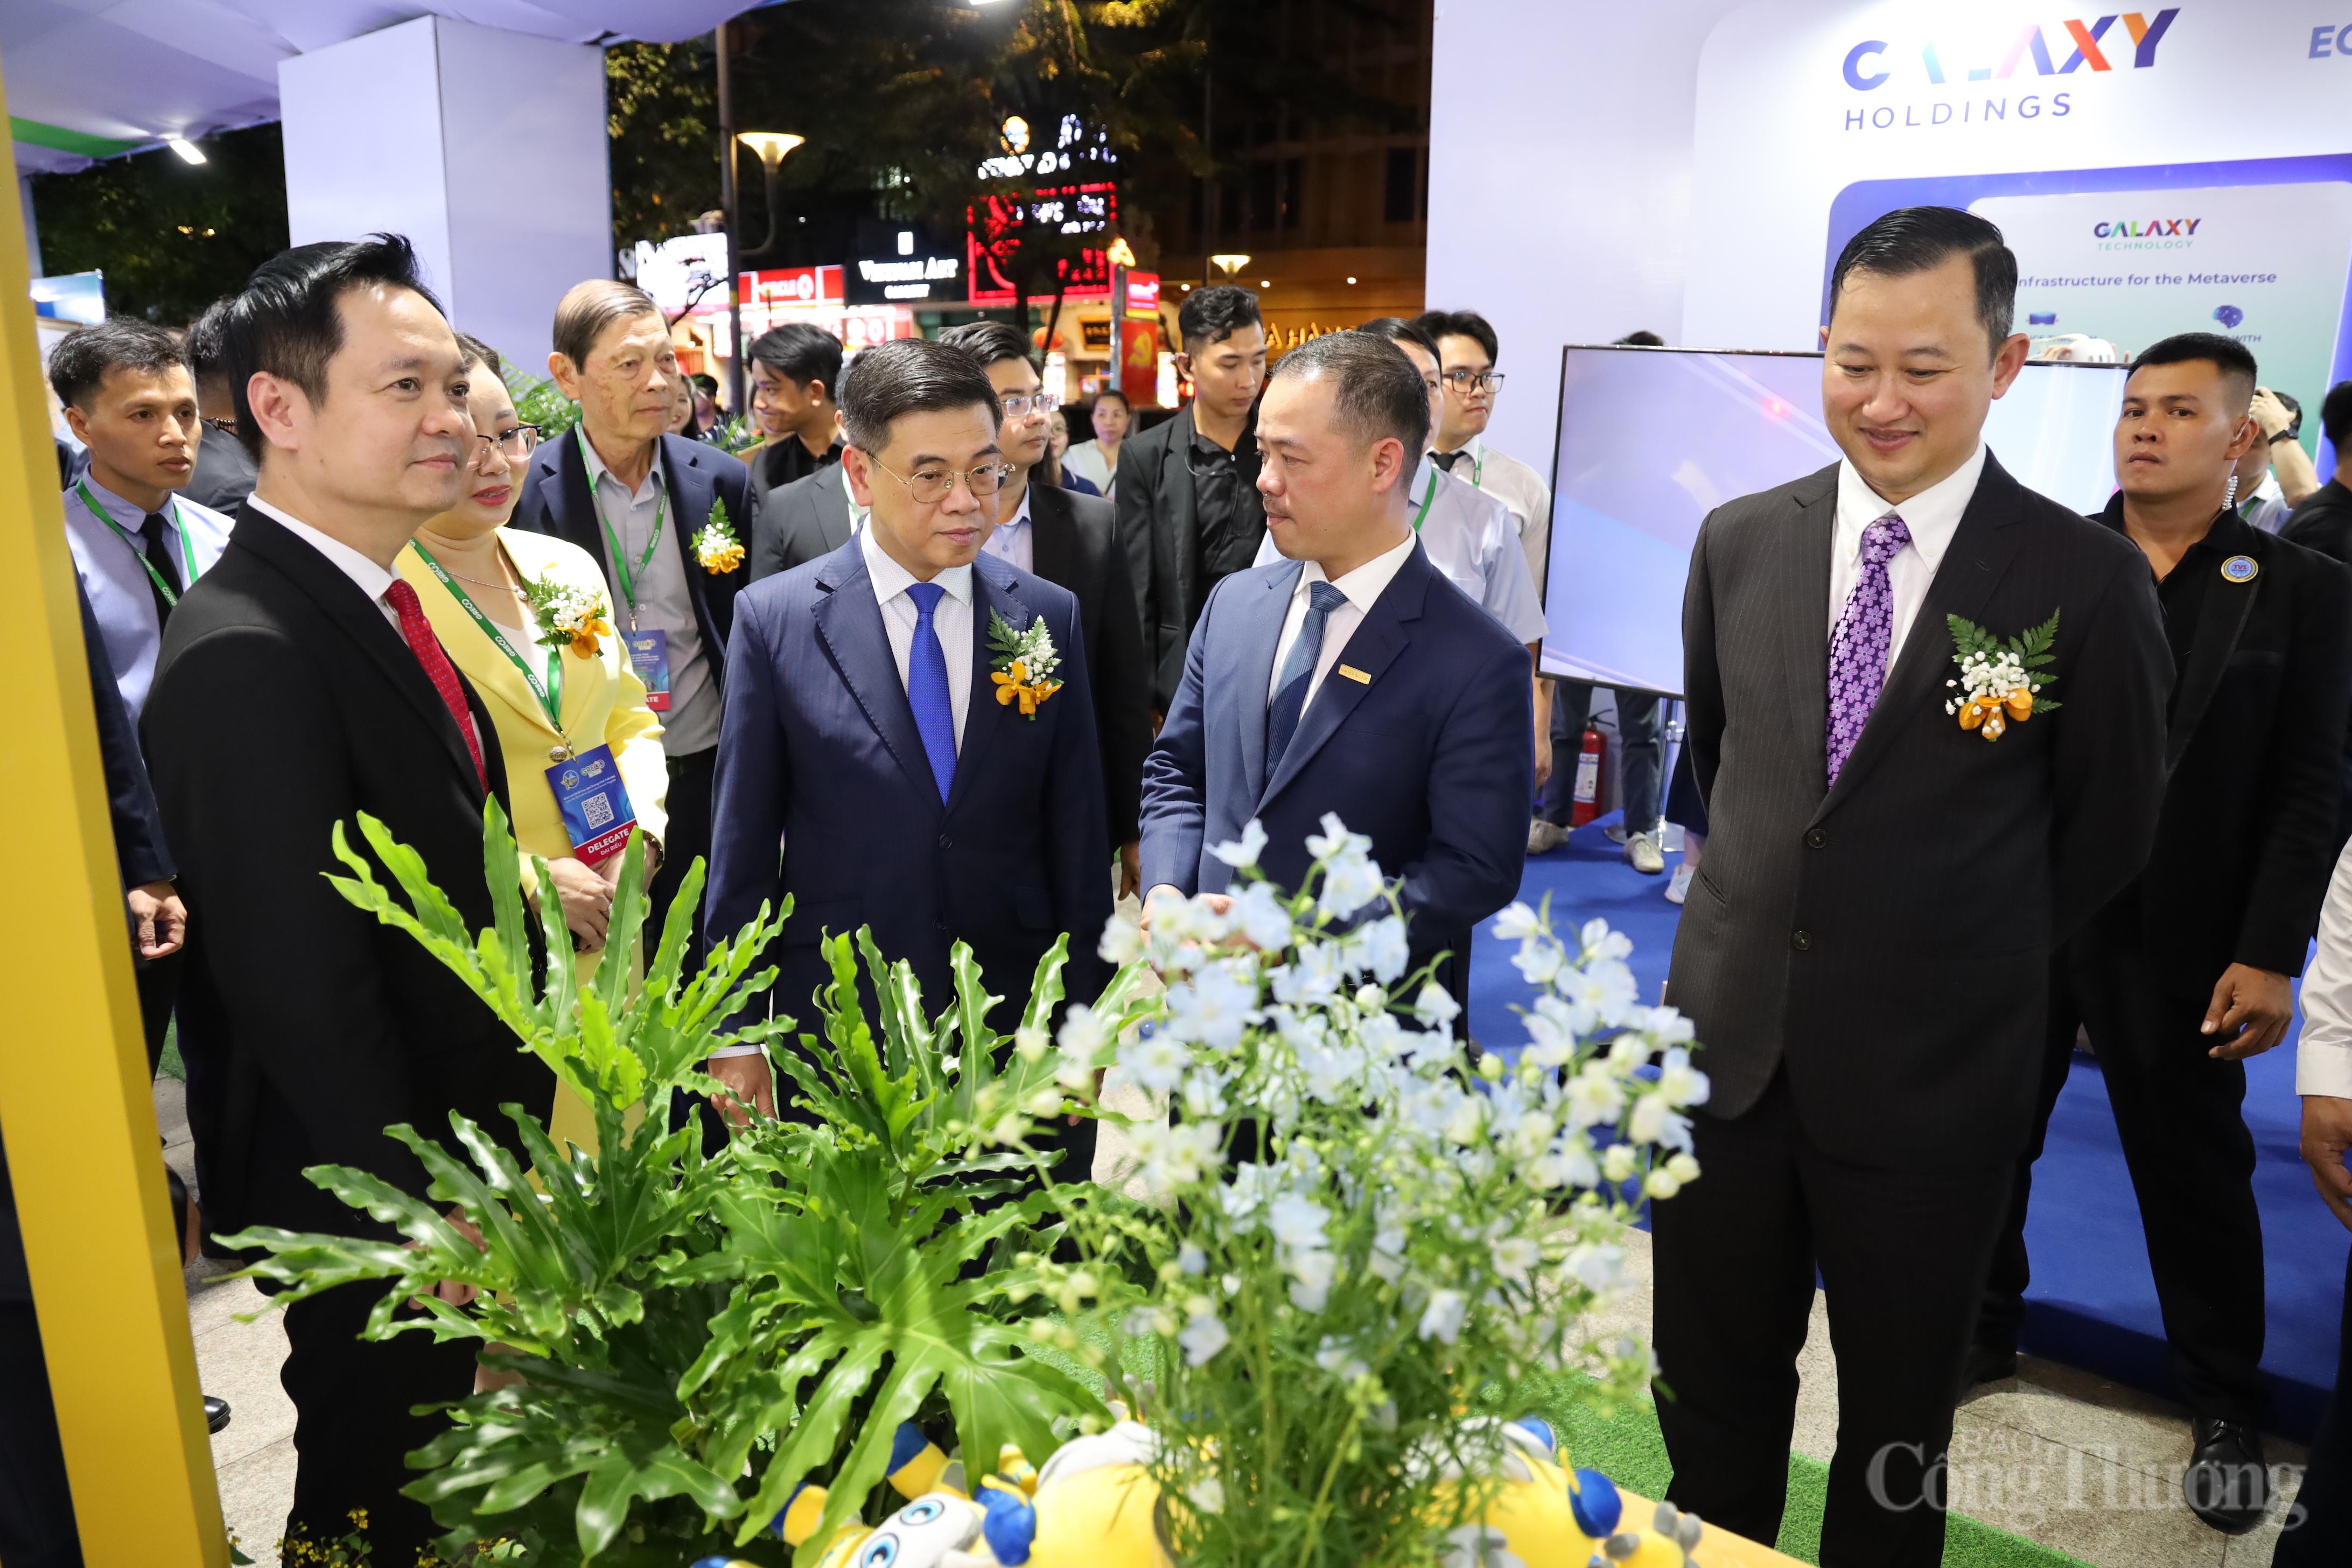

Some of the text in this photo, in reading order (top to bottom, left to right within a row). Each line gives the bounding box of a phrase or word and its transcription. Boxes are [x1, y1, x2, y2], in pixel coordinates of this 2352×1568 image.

[1845, 92, 2071, 130] HOLDINGS
[2094, 218, 2200, 239] GALAXY
[2097, 240, 2193, 251] TECHNOLOGY
[2018, 272, 2277, 287] nfrastructure for the Metaverse
[650, 529, 660, 548] GRECO
[162, 587, 177, 606] GRECO
[461, 598, 482, 620] GRECO
[495, 635, 515, 657] GRECO
[528, 674, 545, 698] GRECO
[587, 828, 629, 854] DELEGATE
